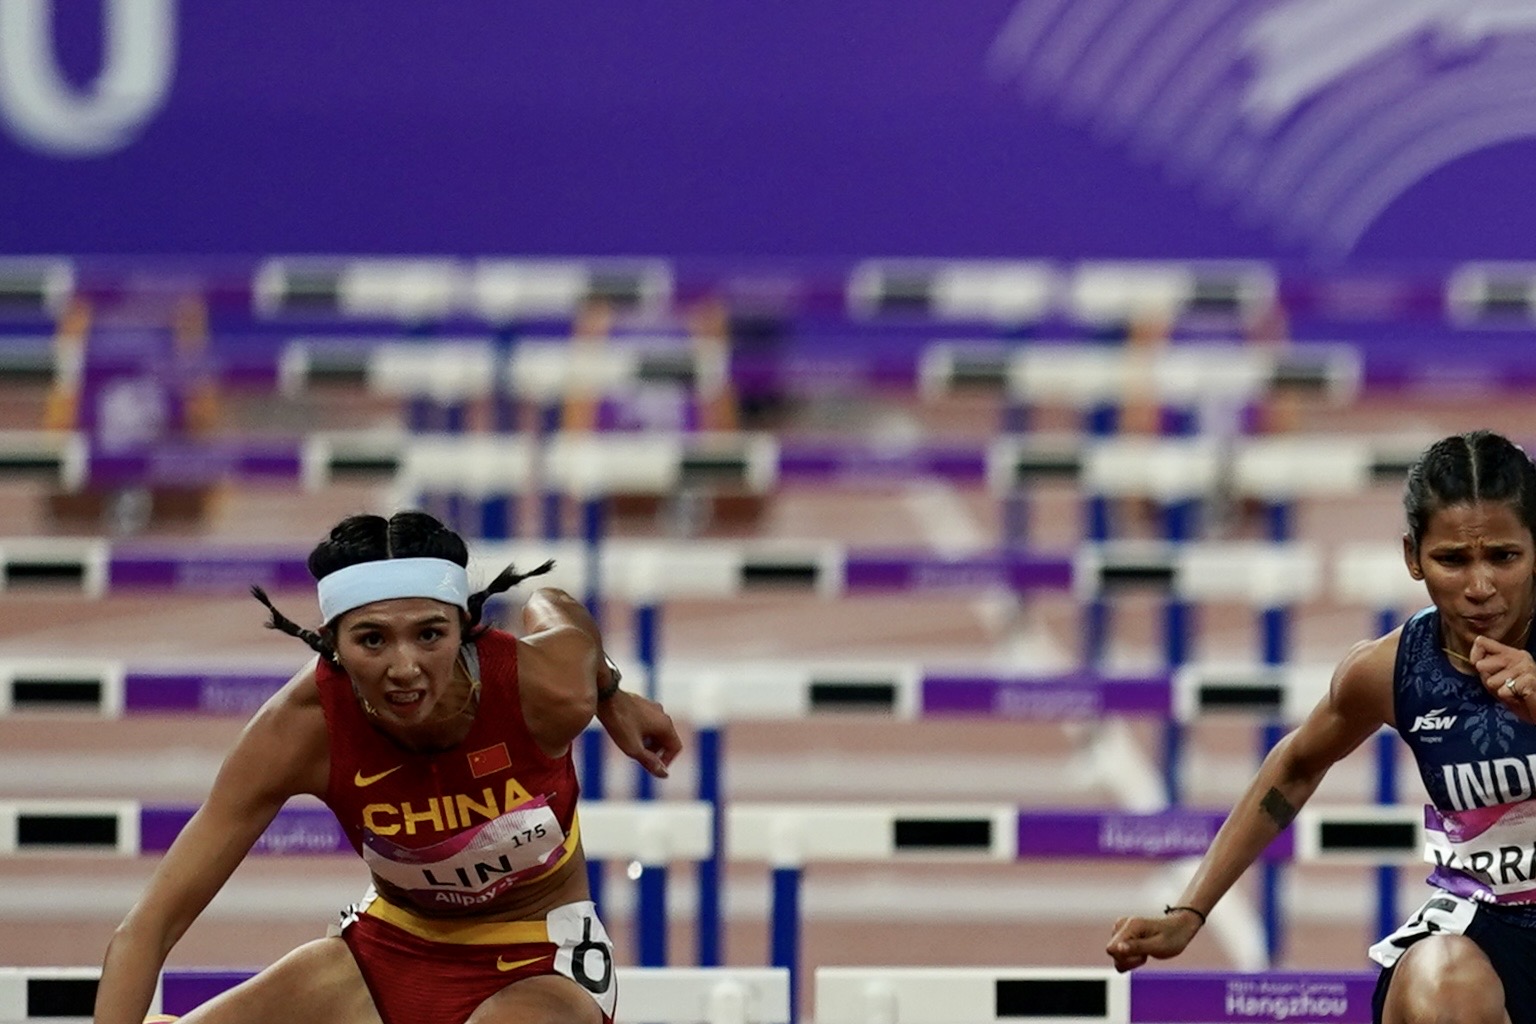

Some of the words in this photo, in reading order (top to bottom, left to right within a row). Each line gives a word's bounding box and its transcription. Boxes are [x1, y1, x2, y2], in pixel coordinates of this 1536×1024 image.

[1409, 711, 1457, 732] JSW
[362, 777, 534, 836] CHINA
[511, 823, 546, 848] 175
[422, 854, 513, 888] LIN
[571, 916, 612, 993] 6
